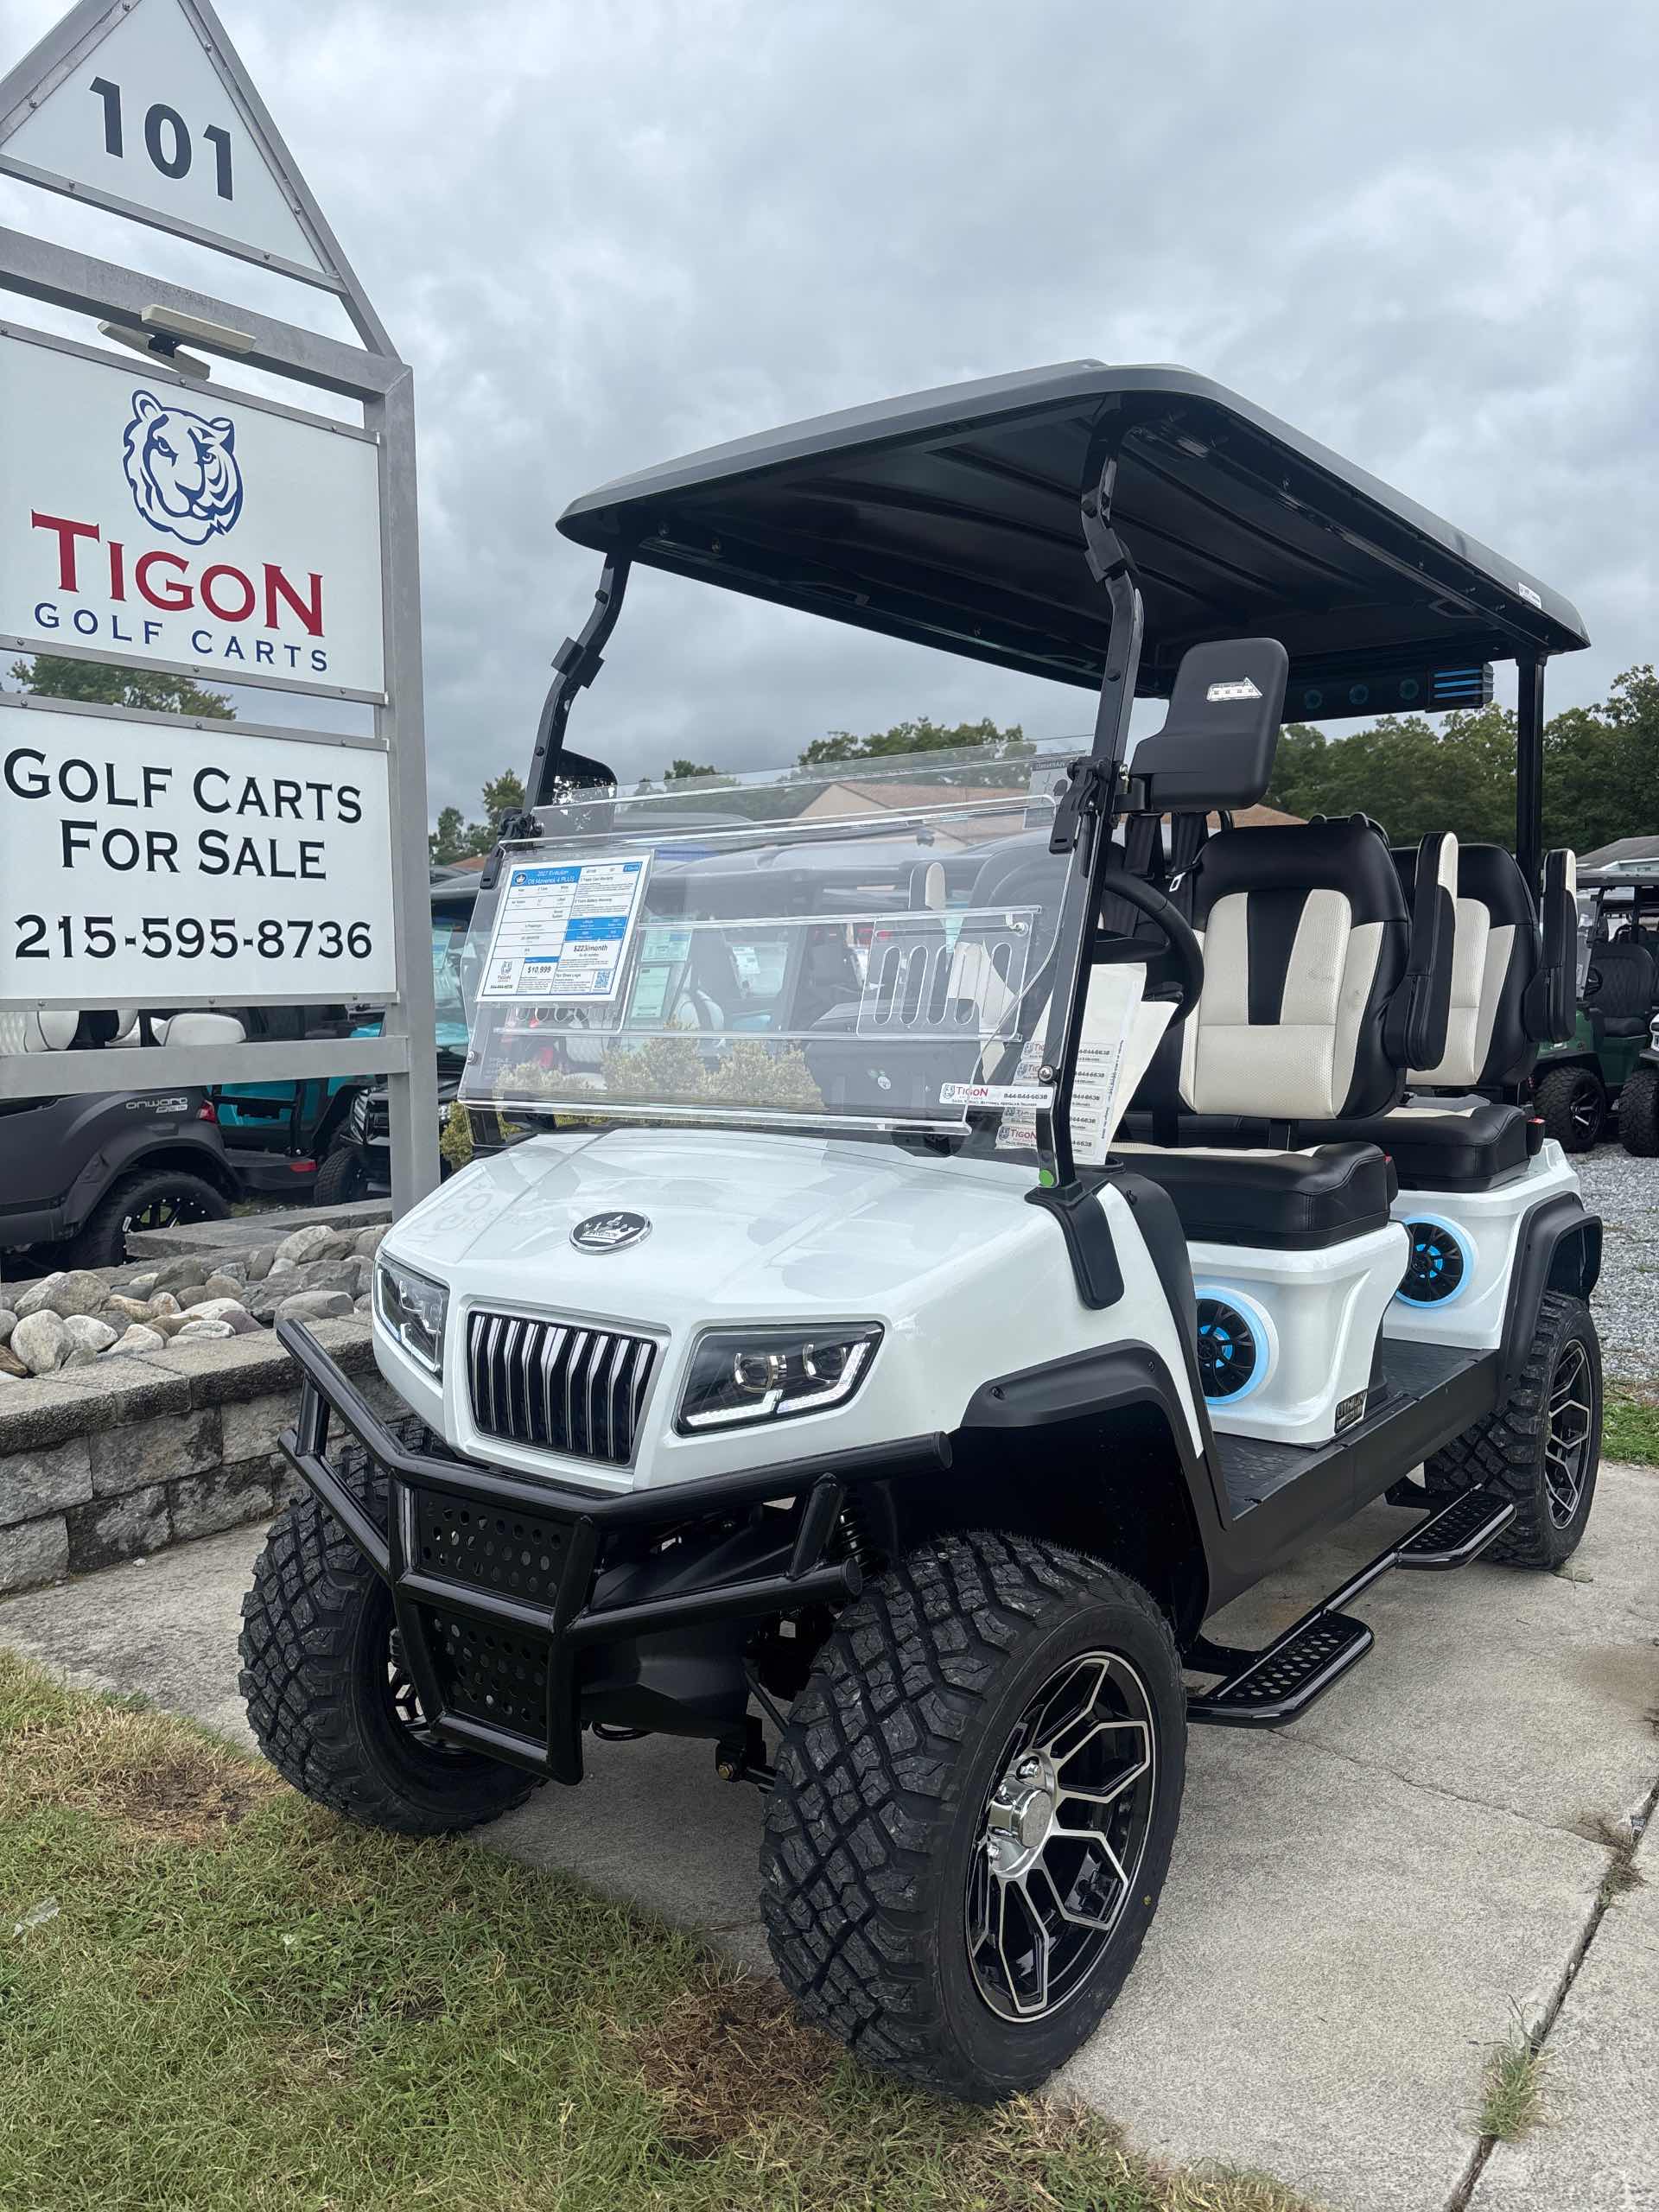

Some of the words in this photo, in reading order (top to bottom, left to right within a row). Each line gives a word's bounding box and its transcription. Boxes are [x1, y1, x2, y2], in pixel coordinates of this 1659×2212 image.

[89, 76, 233, 200] 101
[31, 509, 325, 637] TIGON
[35, 602, 163, 645] GOLF
[192, 630, 327, 671] CARTS
[3, 748, 173, 809] GOLF
[193, 767, 362, 823] CARTS
[60, 819, 180, 873] FOR
[199, 830, 327, 880] SALE
[15, 914, 372, 959] 215-595-8736
[957, 1086, 988, 1097] TIGON
